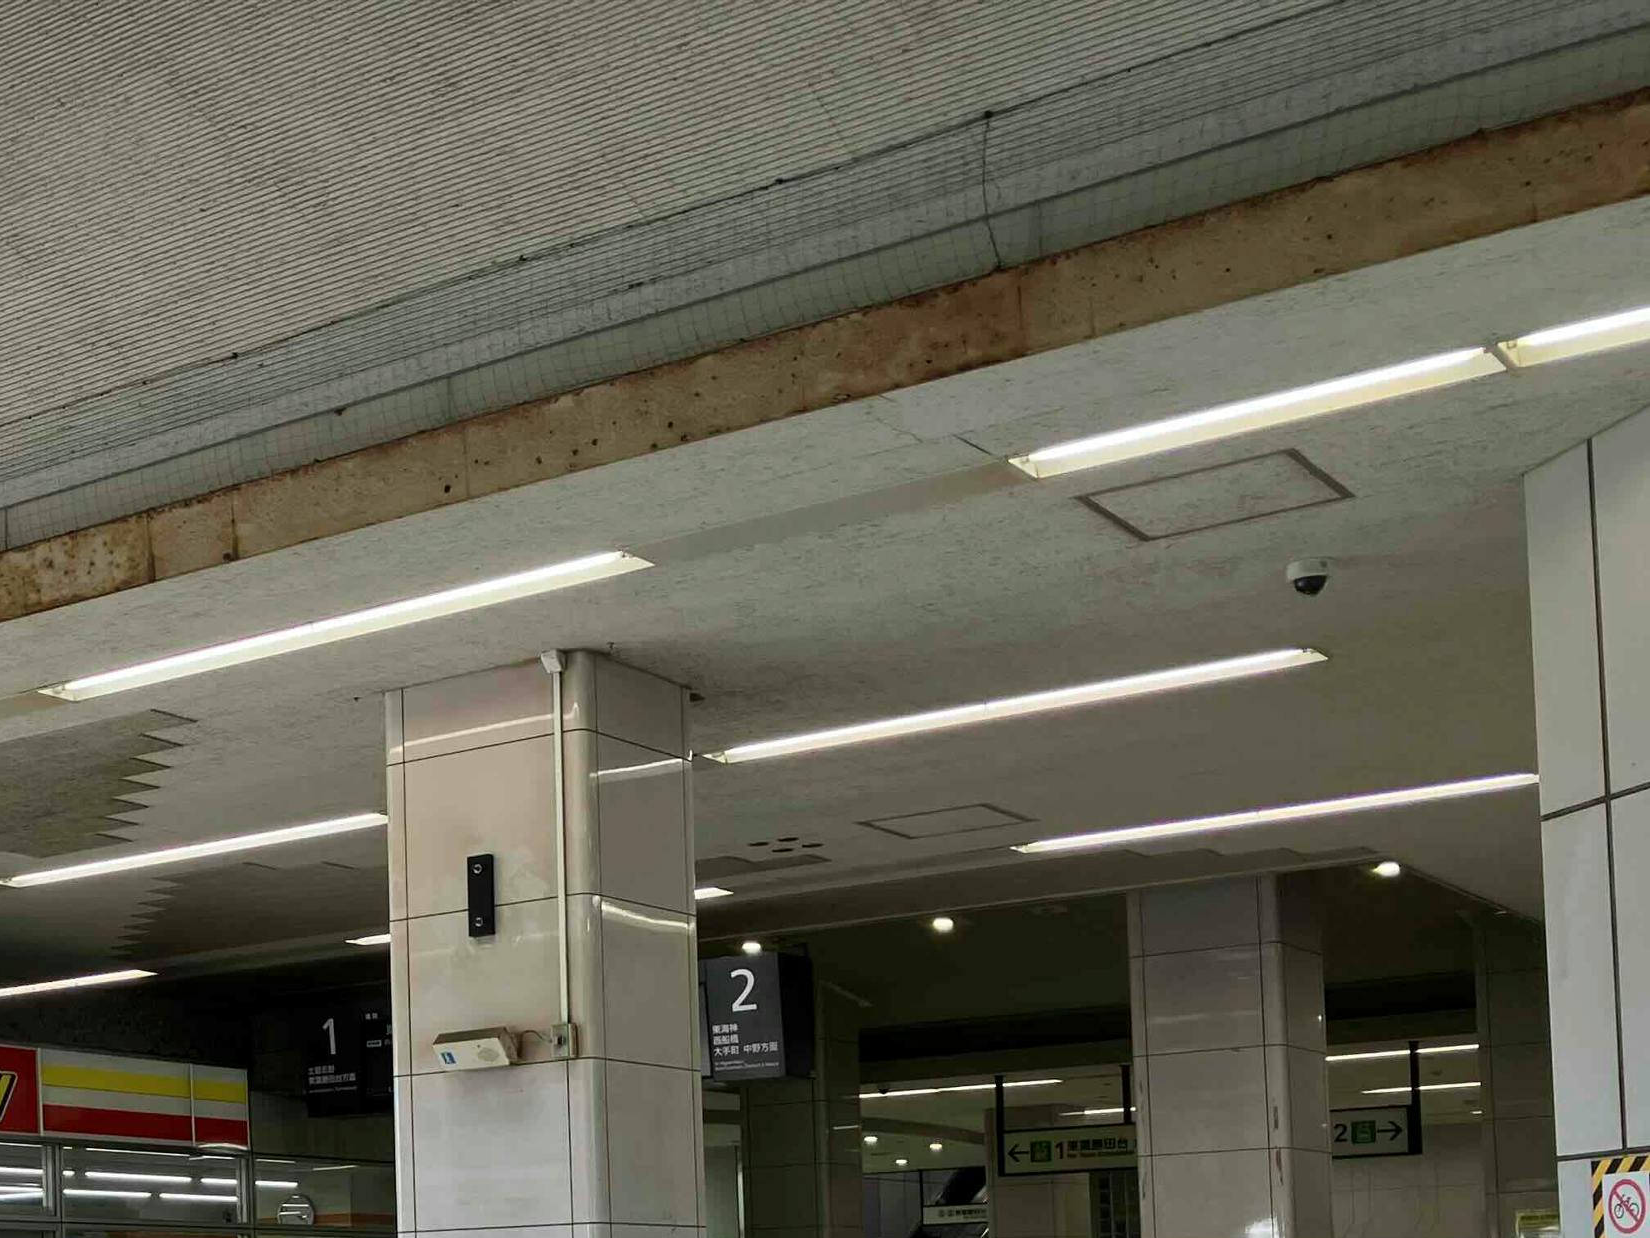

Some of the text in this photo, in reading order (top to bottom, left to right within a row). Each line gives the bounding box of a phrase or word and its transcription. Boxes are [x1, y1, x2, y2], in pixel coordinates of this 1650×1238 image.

[730, 968, 758, 1012] 2
[322, 1017, 337, 1055] 1
[714, 1041, 778, 1057] 大手町 中野方面
[1334, 1124, 1347, 1143] 2
[1055, 1142, 1063, 1159] 1
